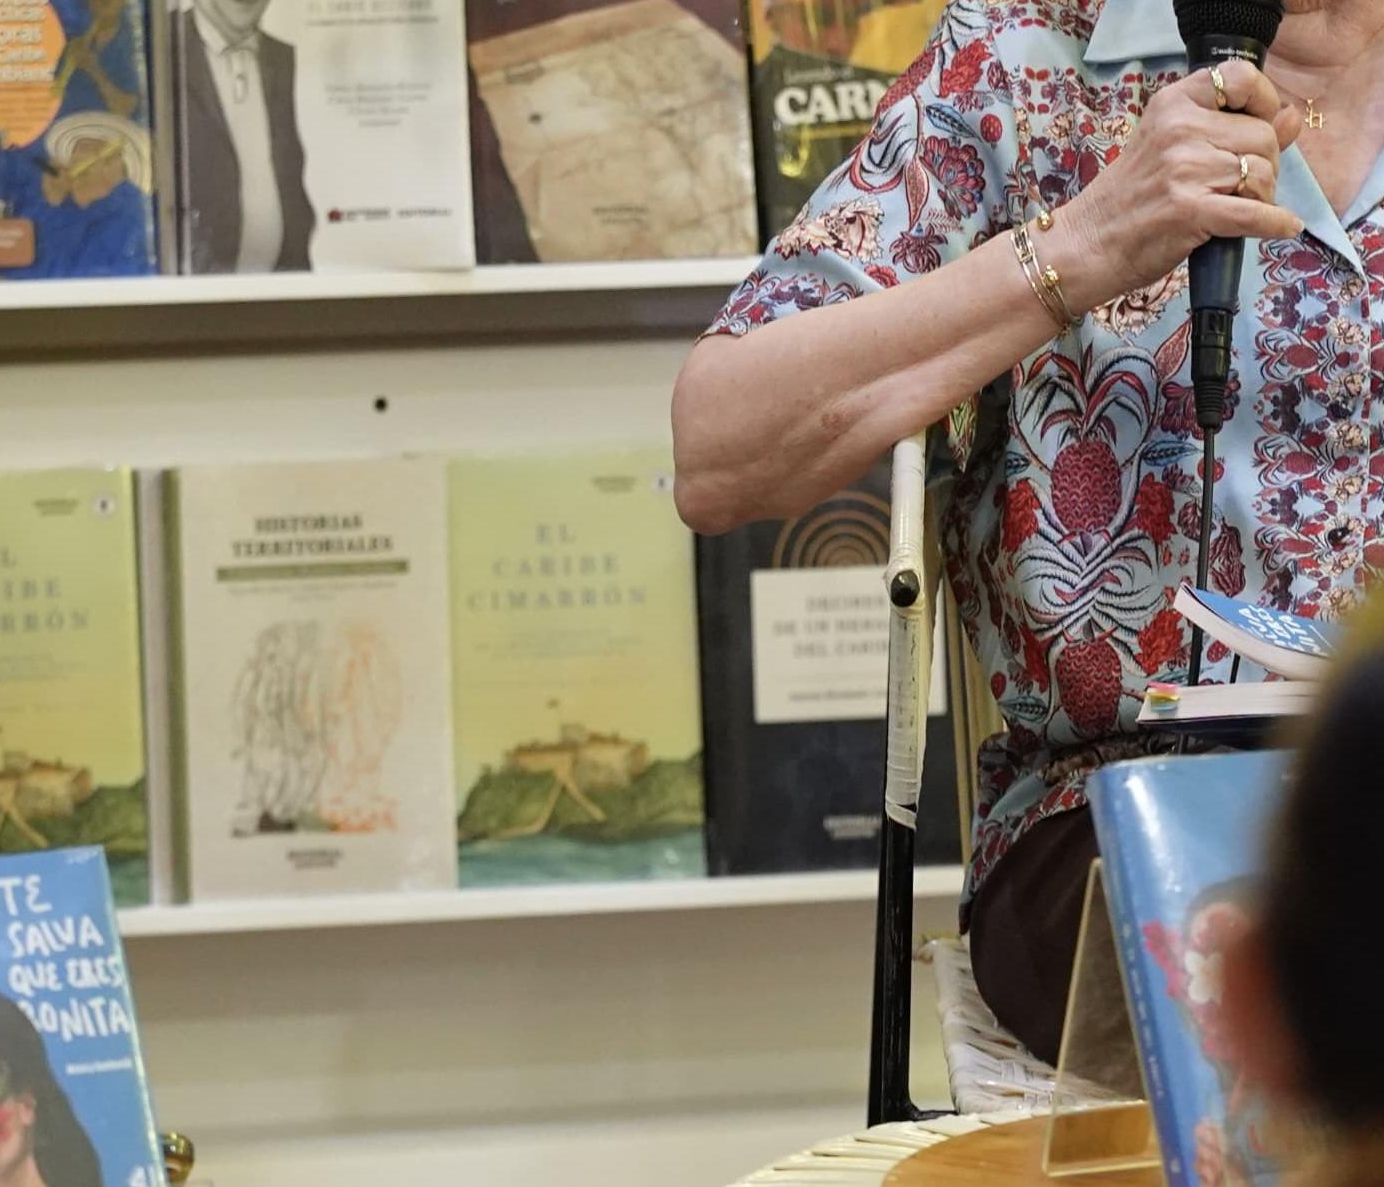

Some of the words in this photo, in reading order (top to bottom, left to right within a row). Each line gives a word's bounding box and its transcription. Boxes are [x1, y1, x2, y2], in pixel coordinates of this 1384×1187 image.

[253, 514, 364, 534] HISTORIAS
[535, 522, 577, 545] EL
[232, 534, 394, 558] TERRITORIALES
[491, 553, 619, 576] CARIBE
[467, 584, 648, 612] CIMARRÓN
[6, 915, 104, 959] SALVA
[8, 964, 62, 998] QUE
[66, 956, 124, 990] ERES
[19, 997, 134, 1043] BONITA
